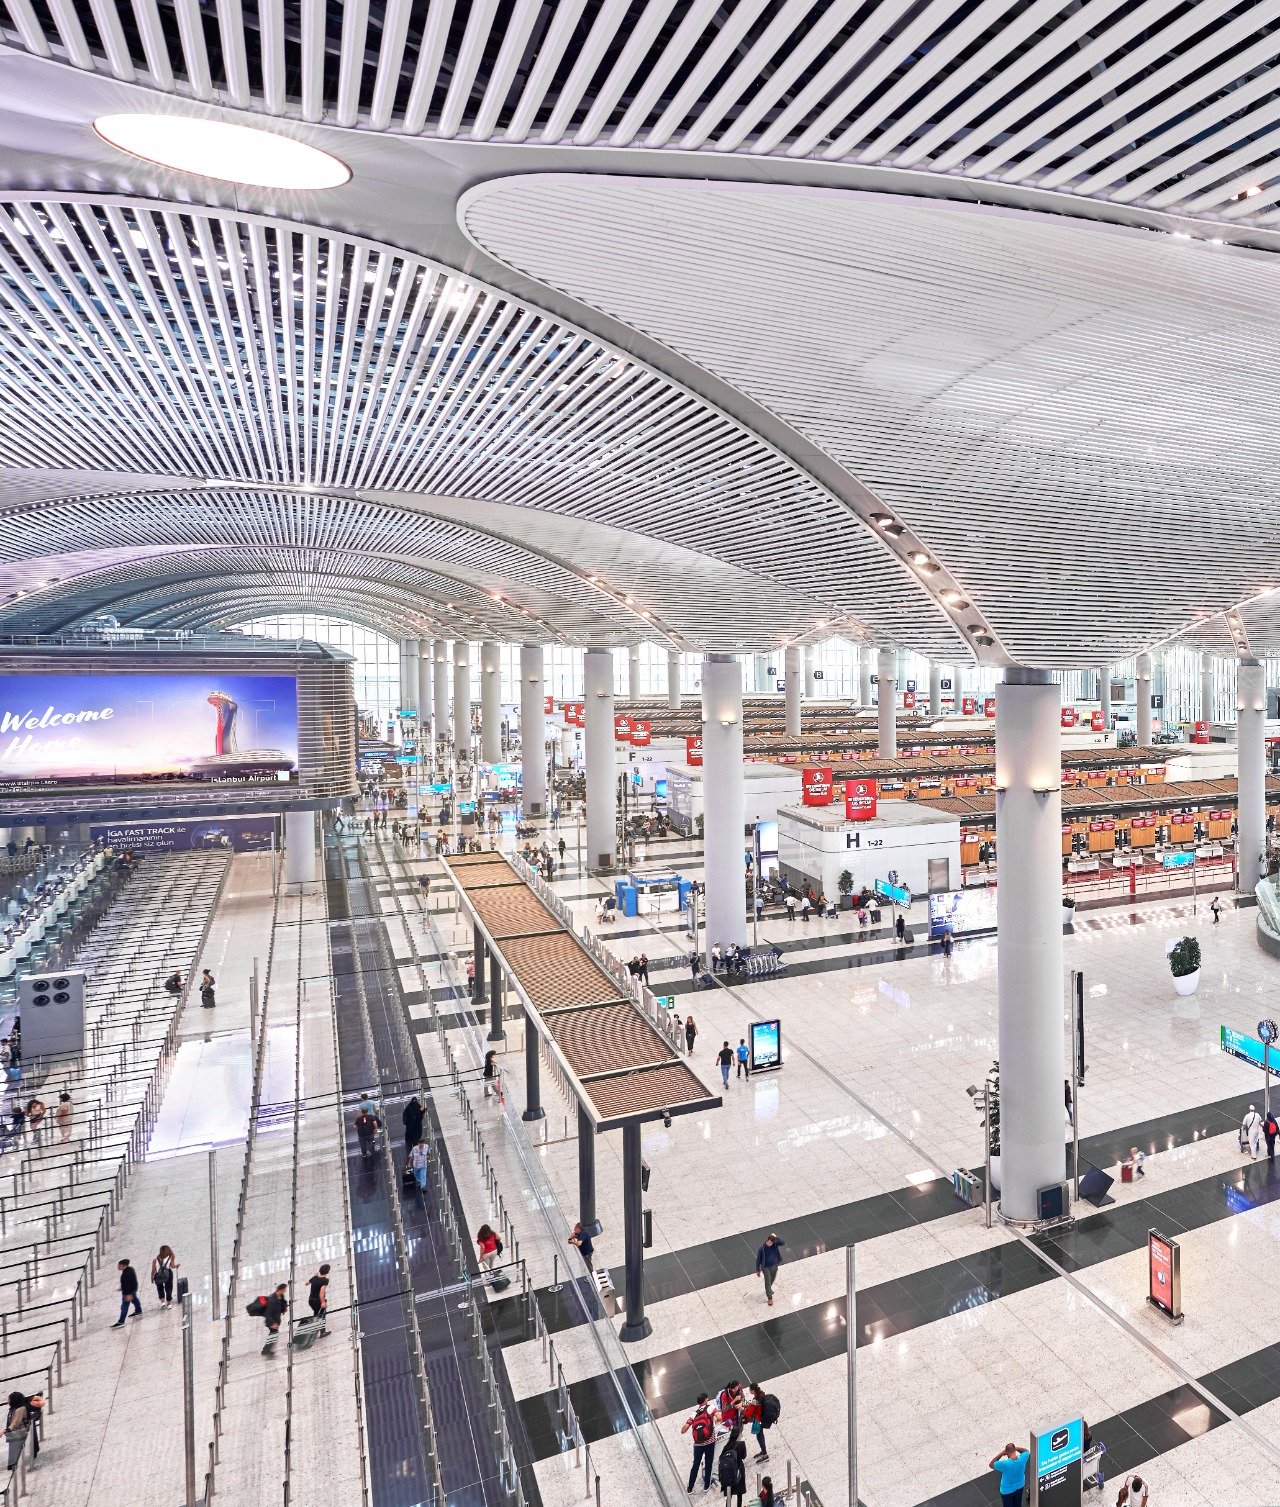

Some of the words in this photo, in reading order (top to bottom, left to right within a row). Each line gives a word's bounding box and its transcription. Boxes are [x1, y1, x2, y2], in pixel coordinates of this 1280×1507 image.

[816, 671, 822, 679] B
[942, 680, 950, 689] D
[1154, 696, 1161, 708] F
[1, 706, 114, 734] Welcome
[1104, 734, 1109, 743] F
[1, 735, 82, 760] Home
[629, 752, 636, 762] F
[846, 832, 861, 848] H
[867, 839, 884, 847] 1-22
